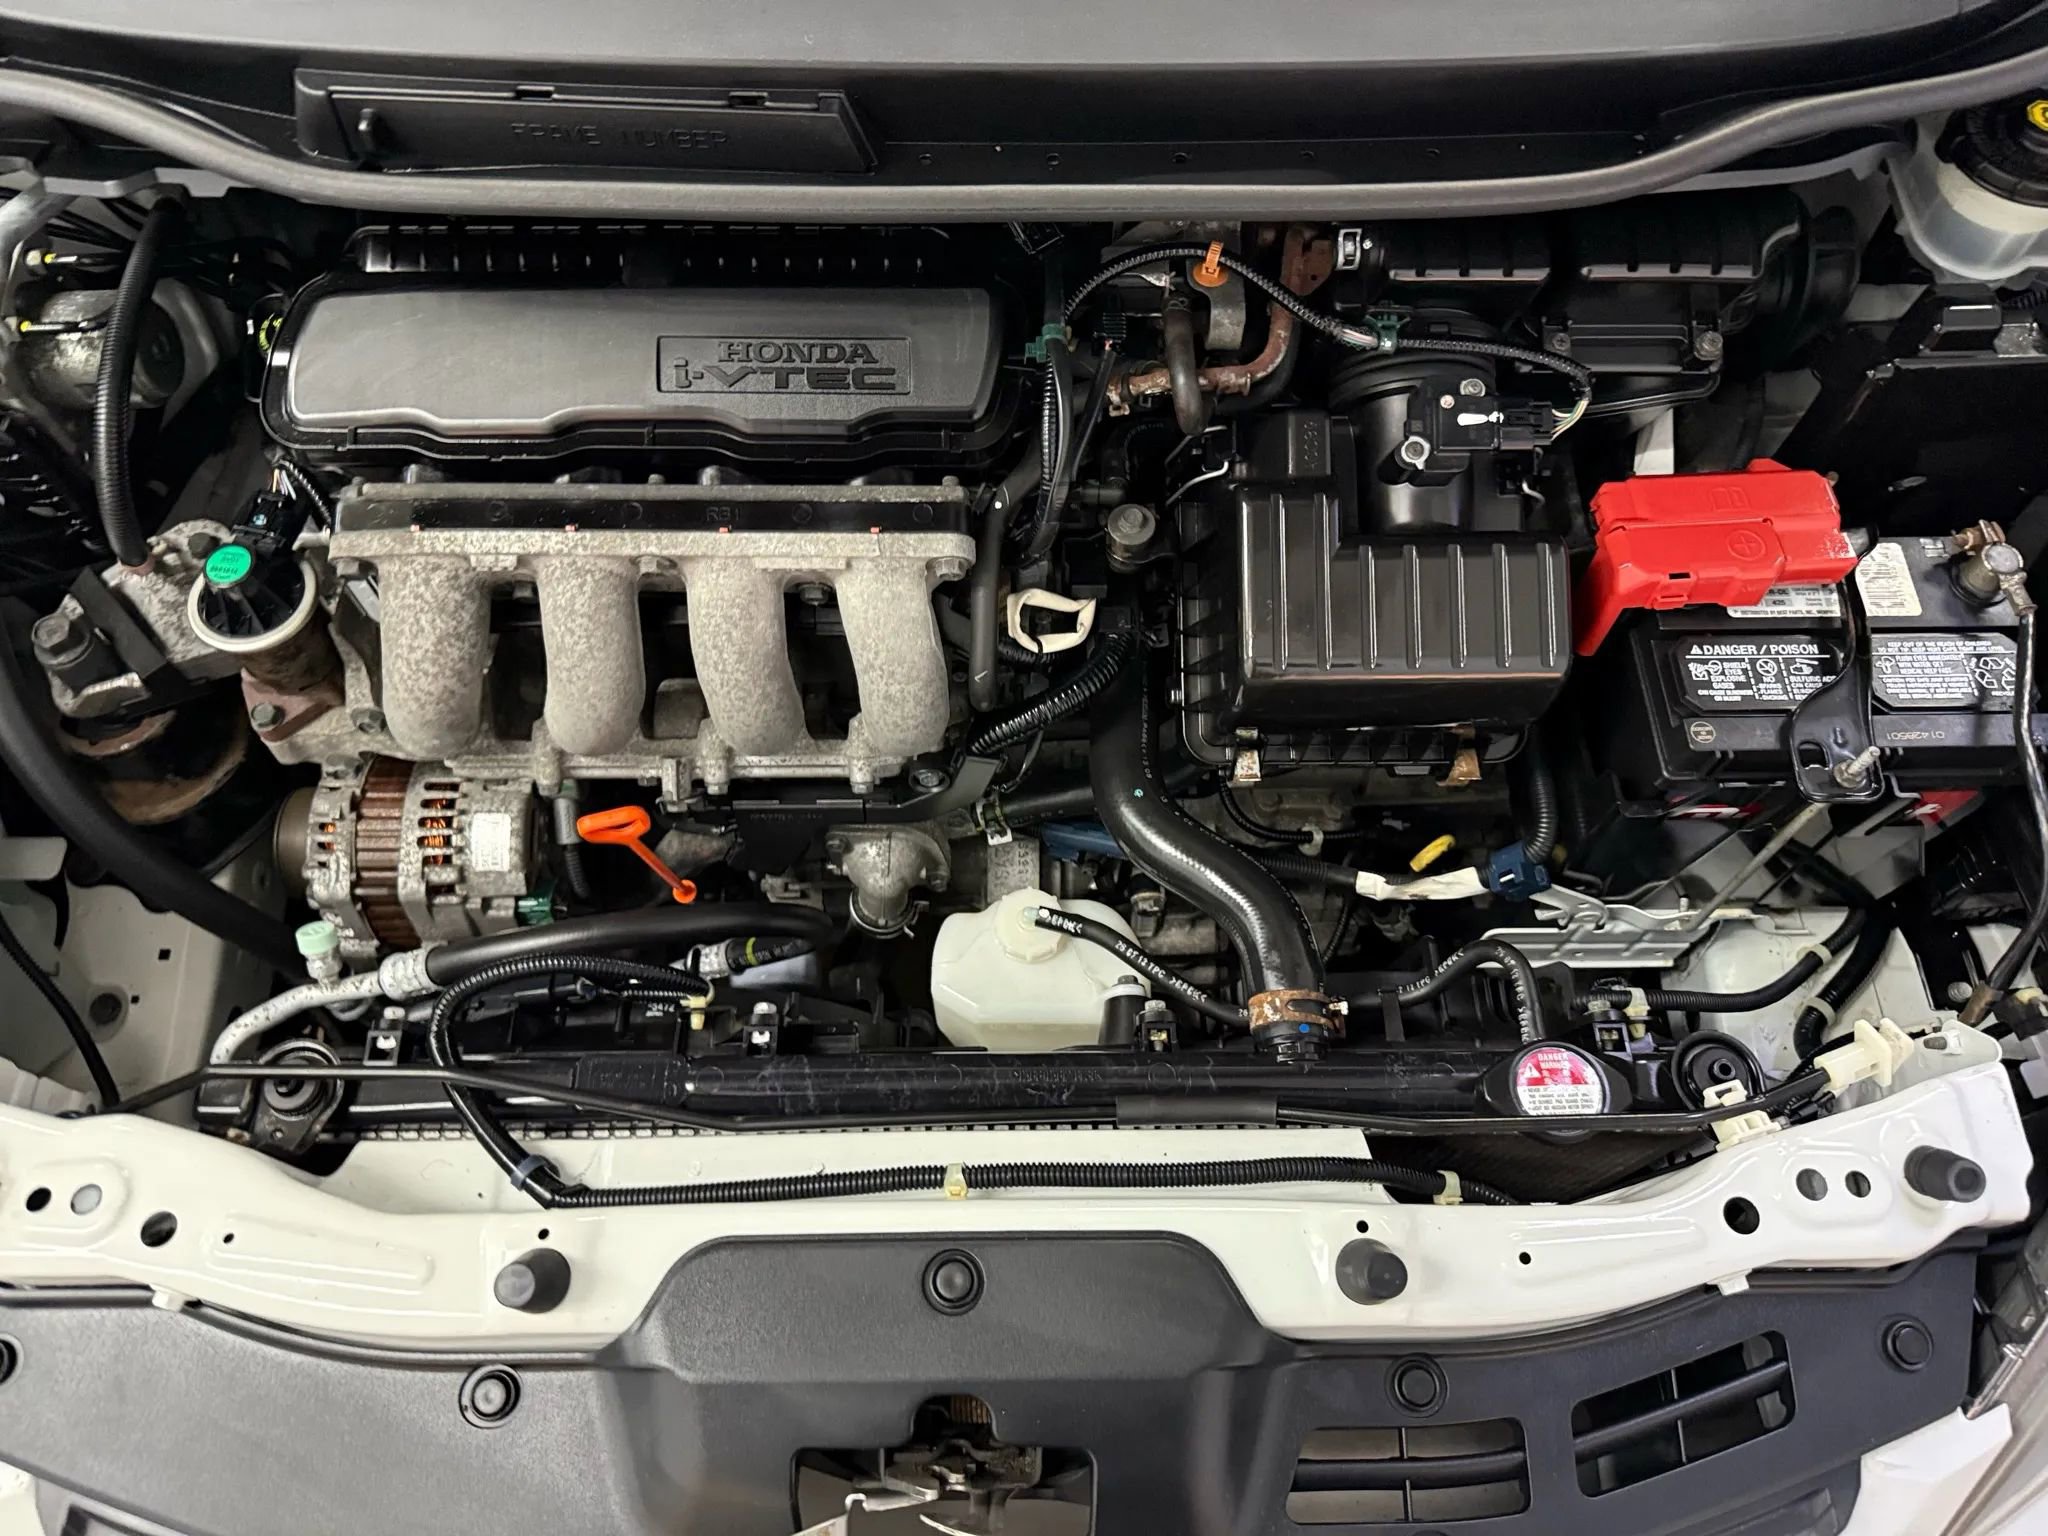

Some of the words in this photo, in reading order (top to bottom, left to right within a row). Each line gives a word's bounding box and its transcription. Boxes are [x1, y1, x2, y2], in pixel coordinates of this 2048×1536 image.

[512, 123, 600, 145] FRAME
[619, 128, 728, 149] NUMBER
[718, 341, 879, 364] HONDA
[673, 357, 897, 390] i-VTEC
[1702, 644, 1757, 655] DANGER
[1760, 645, 1768, 655] /
[1768, 644, 1820, 655] POISON
[1537, 1053, 1568, 1061] DANGER
